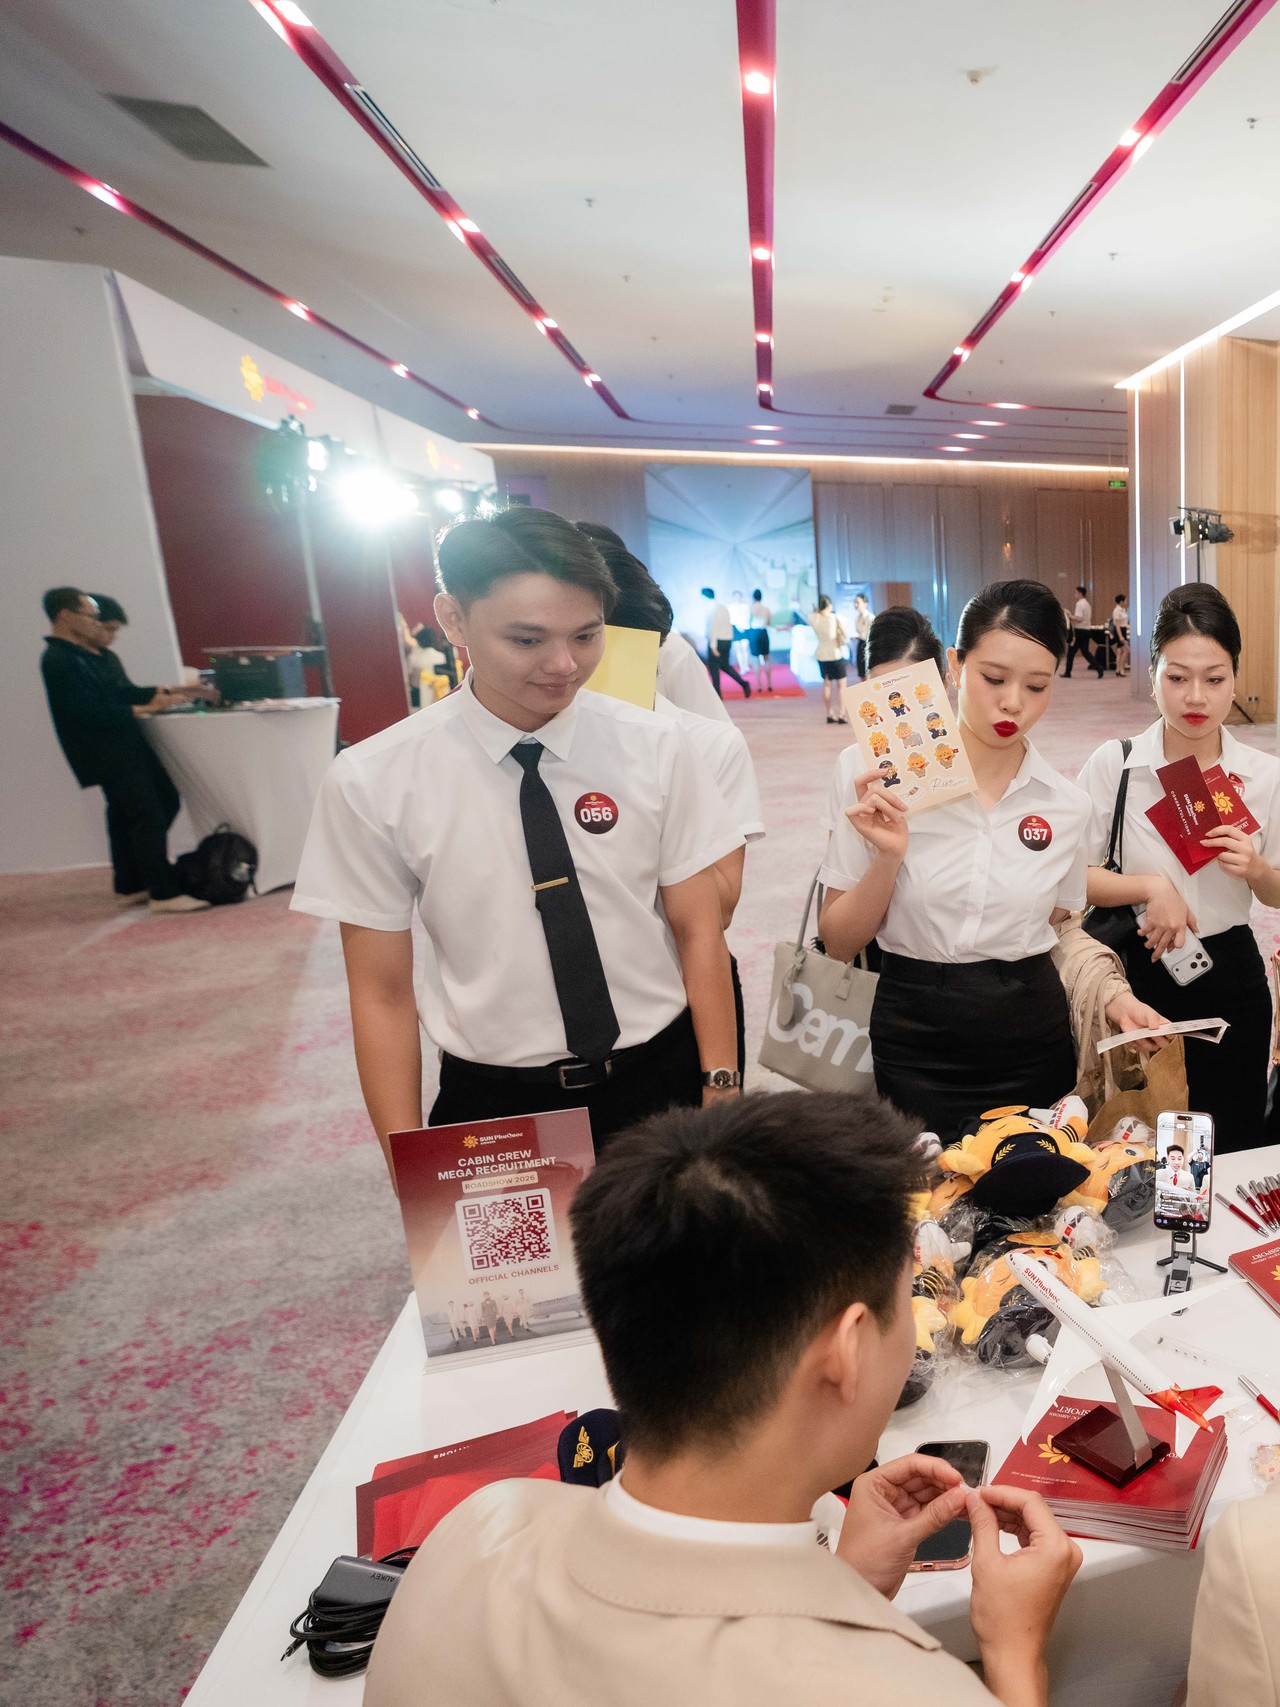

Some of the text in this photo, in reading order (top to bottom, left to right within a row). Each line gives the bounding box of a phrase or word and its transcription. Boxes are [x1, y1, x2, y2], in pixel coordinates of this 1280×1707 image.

[580, 806, 613, 823] 056
[1168, 789, 1192, 835] CONGRATULATIONS
[1023, 828, 1048, 841] 037
[457, 1149, 532, 1167] CABIN CREW
[437, 1156, 557, 1181] MEGA RECRUITMENT
[464, 1174, 536, 1190] ROADSHOW 2026
[468, 1264, 560, 1285] OFFICIAL CHANNELS
[1024, 1267, 1060, 1303] SUN PhuQuoc
[369, 1572, 397, 1583] AUKEY
